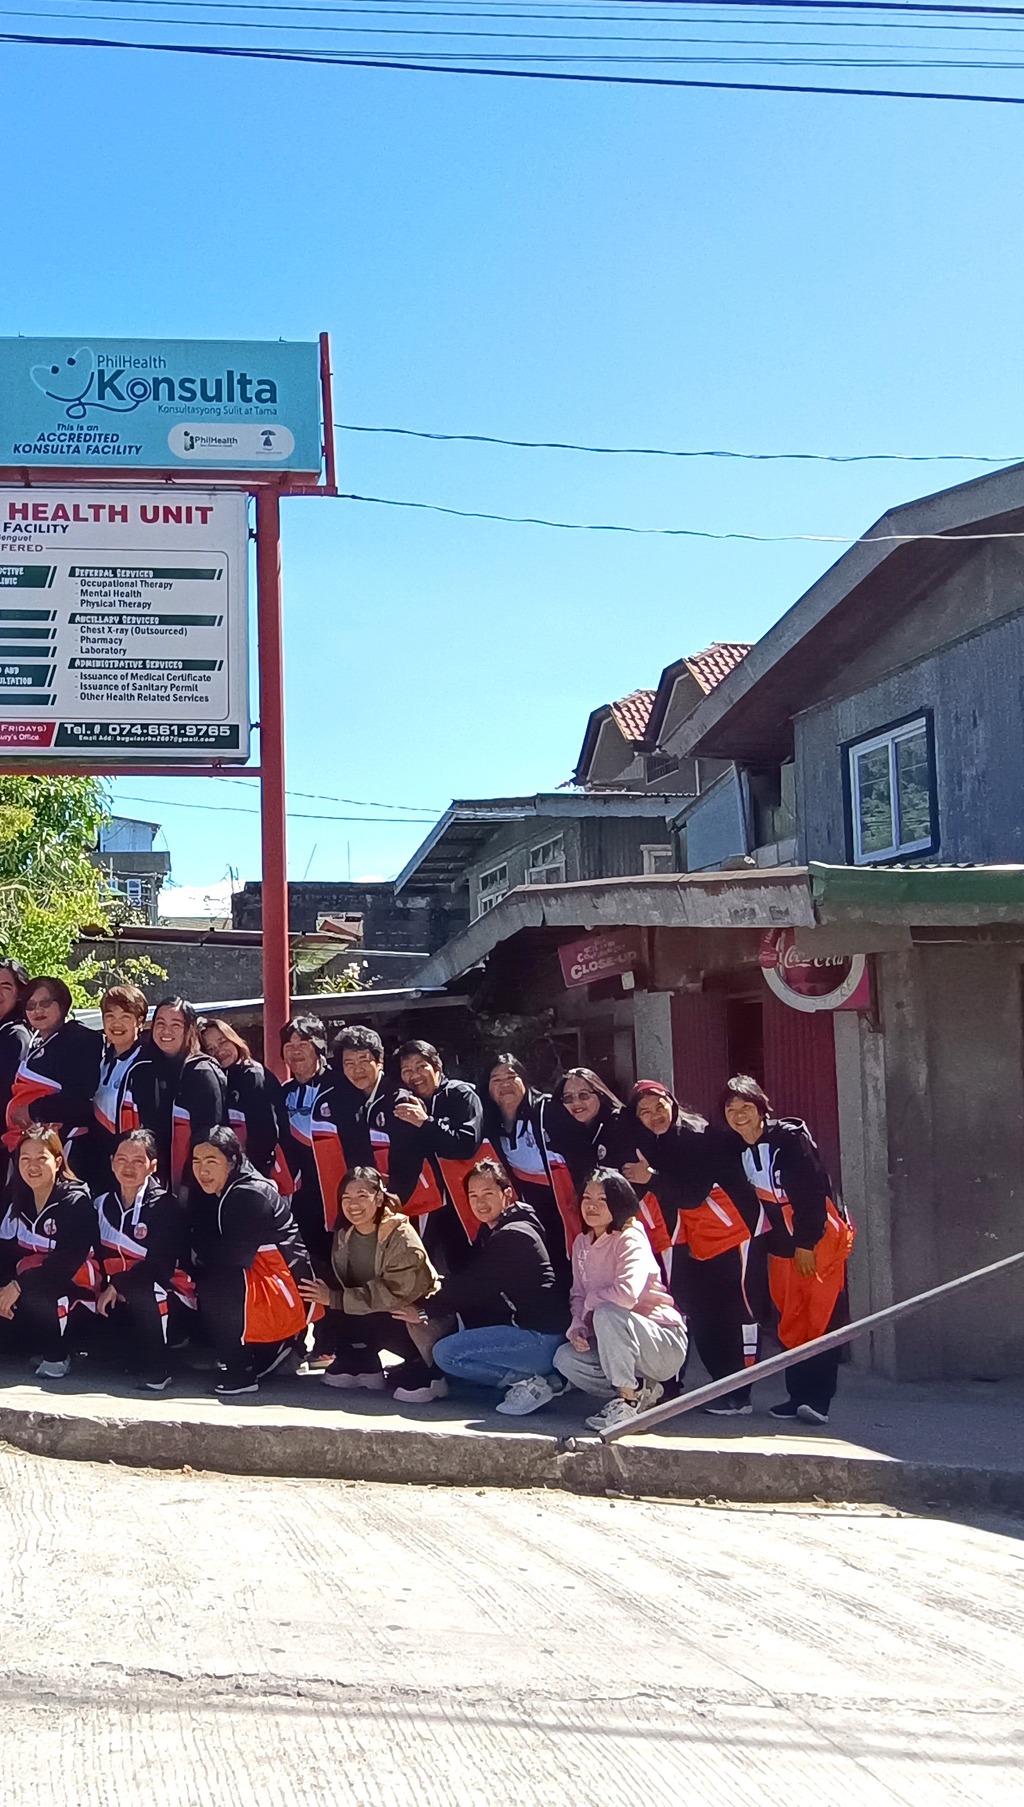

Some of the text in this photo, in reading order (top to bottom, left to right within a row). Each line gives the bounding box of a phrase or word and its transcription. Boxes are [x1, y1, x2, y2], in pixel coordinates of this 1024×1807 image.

[97, 355, 166, 369] PhilHealth
[97, 369, 278, 404] Konsulta
[158, 405, 277, 416] Konsultasyong Sulit at Tama
[57, 423, 75, 432] This
[76, 424, 84, 432] is
[36, 432, 120, 443] ACCREDITED
[194, 435, 238, 445] PhilHealth
[13, 443, 143, 455] KONSULTA FACILITY
[8, 502, 128, 523] HEALTH
[140, 505, 214, 525] UNIT
[3, 522, 69, 534] FACILITY
[80, 579, 173, 590] Occupational Therapy
[80, 589, 142, 598] Mental Health
[80, 599, 152, 610] Physical Therapy
[80, 626, 188, 637] Chest X-ray (Outsourced)
[80, 636, 123, 646] Pharmacy
[80, 646, 127, 656] Laboratory
[80, 672, 211, 682] Issuance of Medical Certificate
[80, 682, 198, 693] Issuance of Sanitary Permit
[80, 692, 209, 702] Other Health Related Services
[64, 724, 91, 734] Tel.
